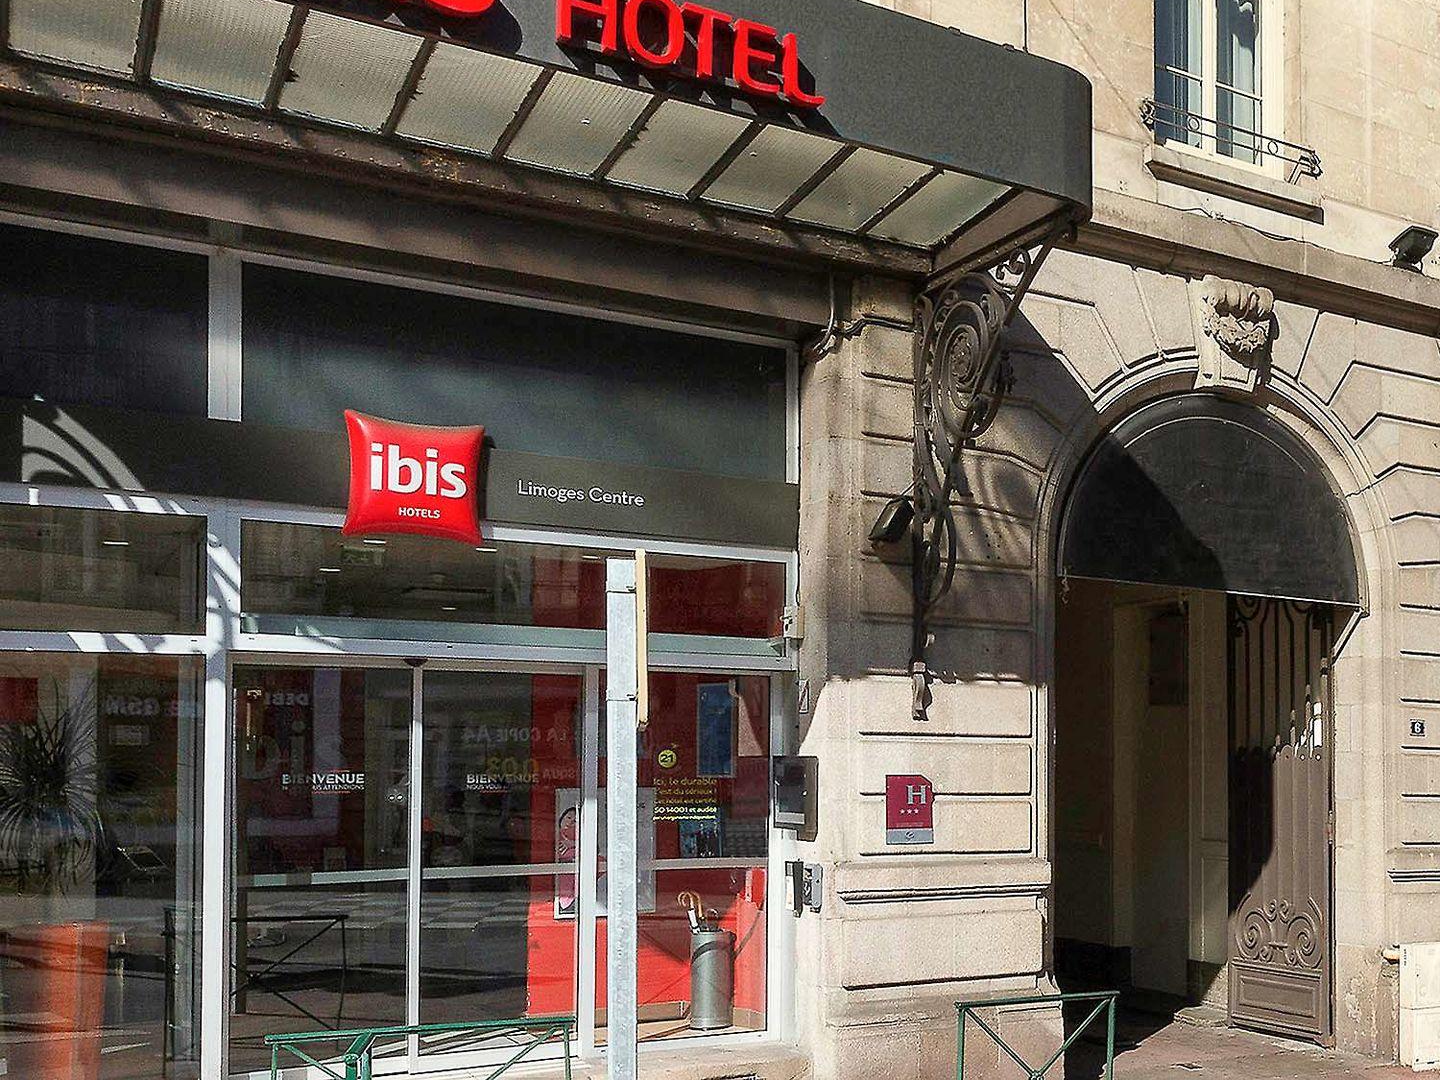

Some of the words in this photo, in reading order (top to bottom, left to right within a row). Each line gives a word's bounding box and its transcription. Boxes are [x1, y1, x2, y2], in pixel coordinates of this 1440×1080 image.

[370, 442, 467, 499] ibis
[517, 479, 585, 503] Limoges
[588, 487, 645, 507] Centre
[398, 506, 440, 519] HOTELS
[660, 754, 674, 763] 21
[466, 774, 540, 784] BIENVENUE
[906, 785, 927, 804] H
